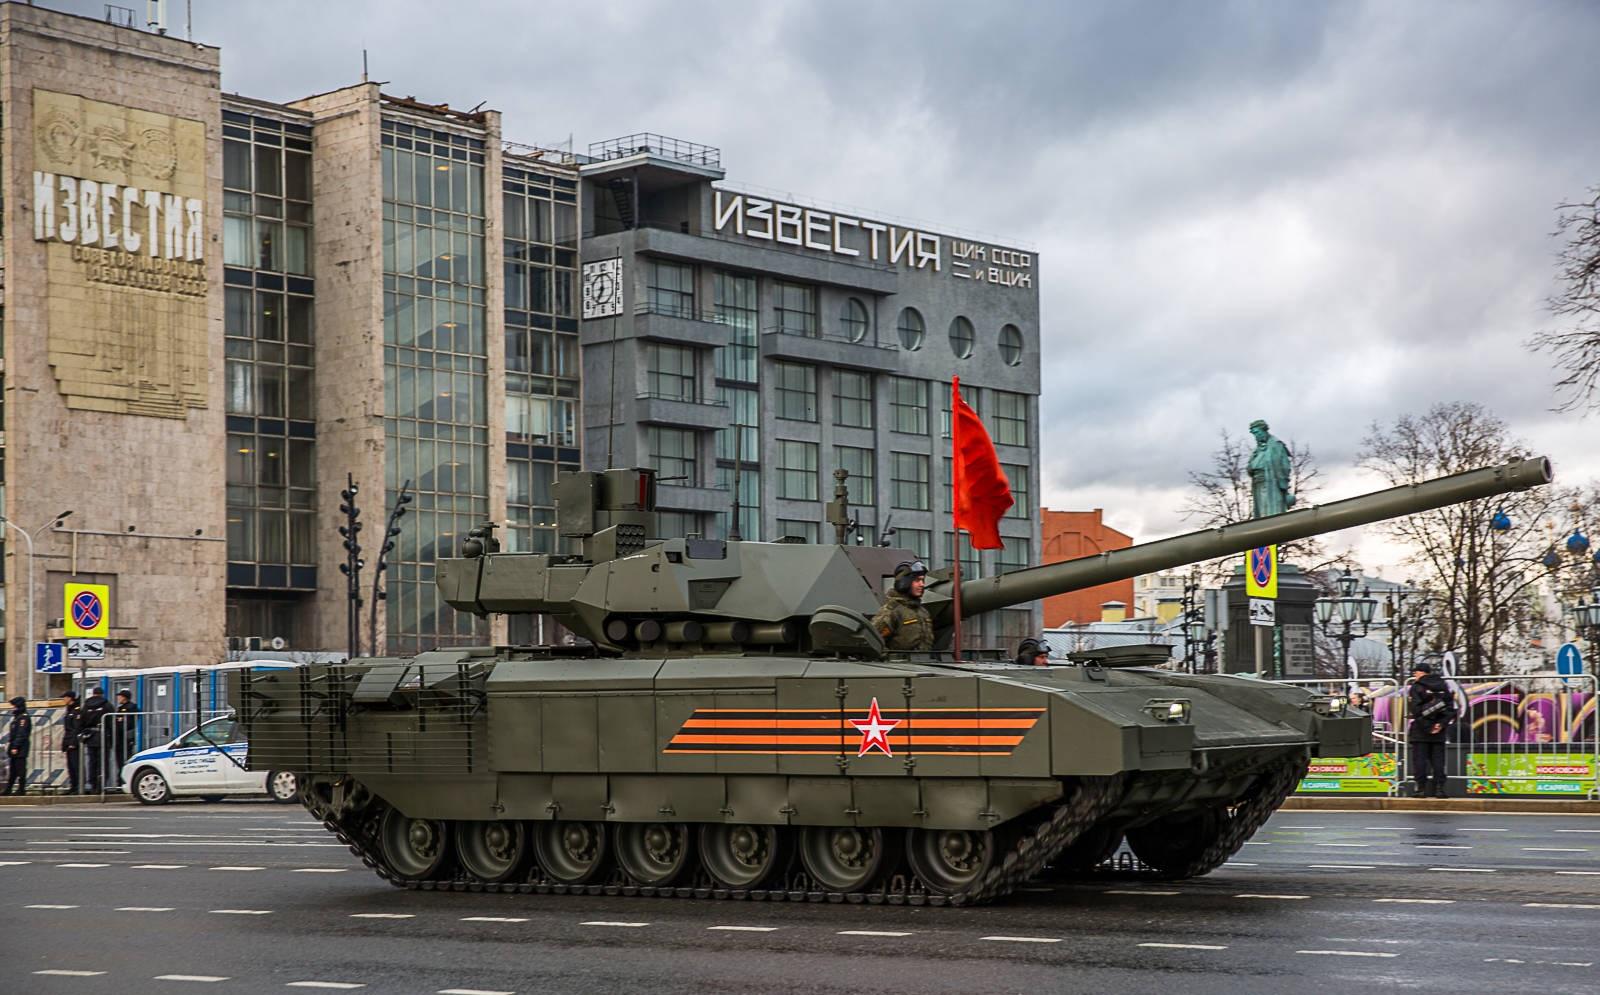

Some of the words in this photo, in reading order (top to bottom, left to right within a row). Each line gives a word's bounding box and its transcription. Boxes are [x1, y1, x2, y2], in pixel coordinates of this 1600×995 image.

[33, 171, 203, 262] ИЗВЕСТИЯ
[714, 191, 941, 271] ИЗВЕСТИЯ
[952, 240, 986, 261] ЦИК
[991, 248, 1031, 268] СССР
[988, 267, 1032, 288] ВЦИК
